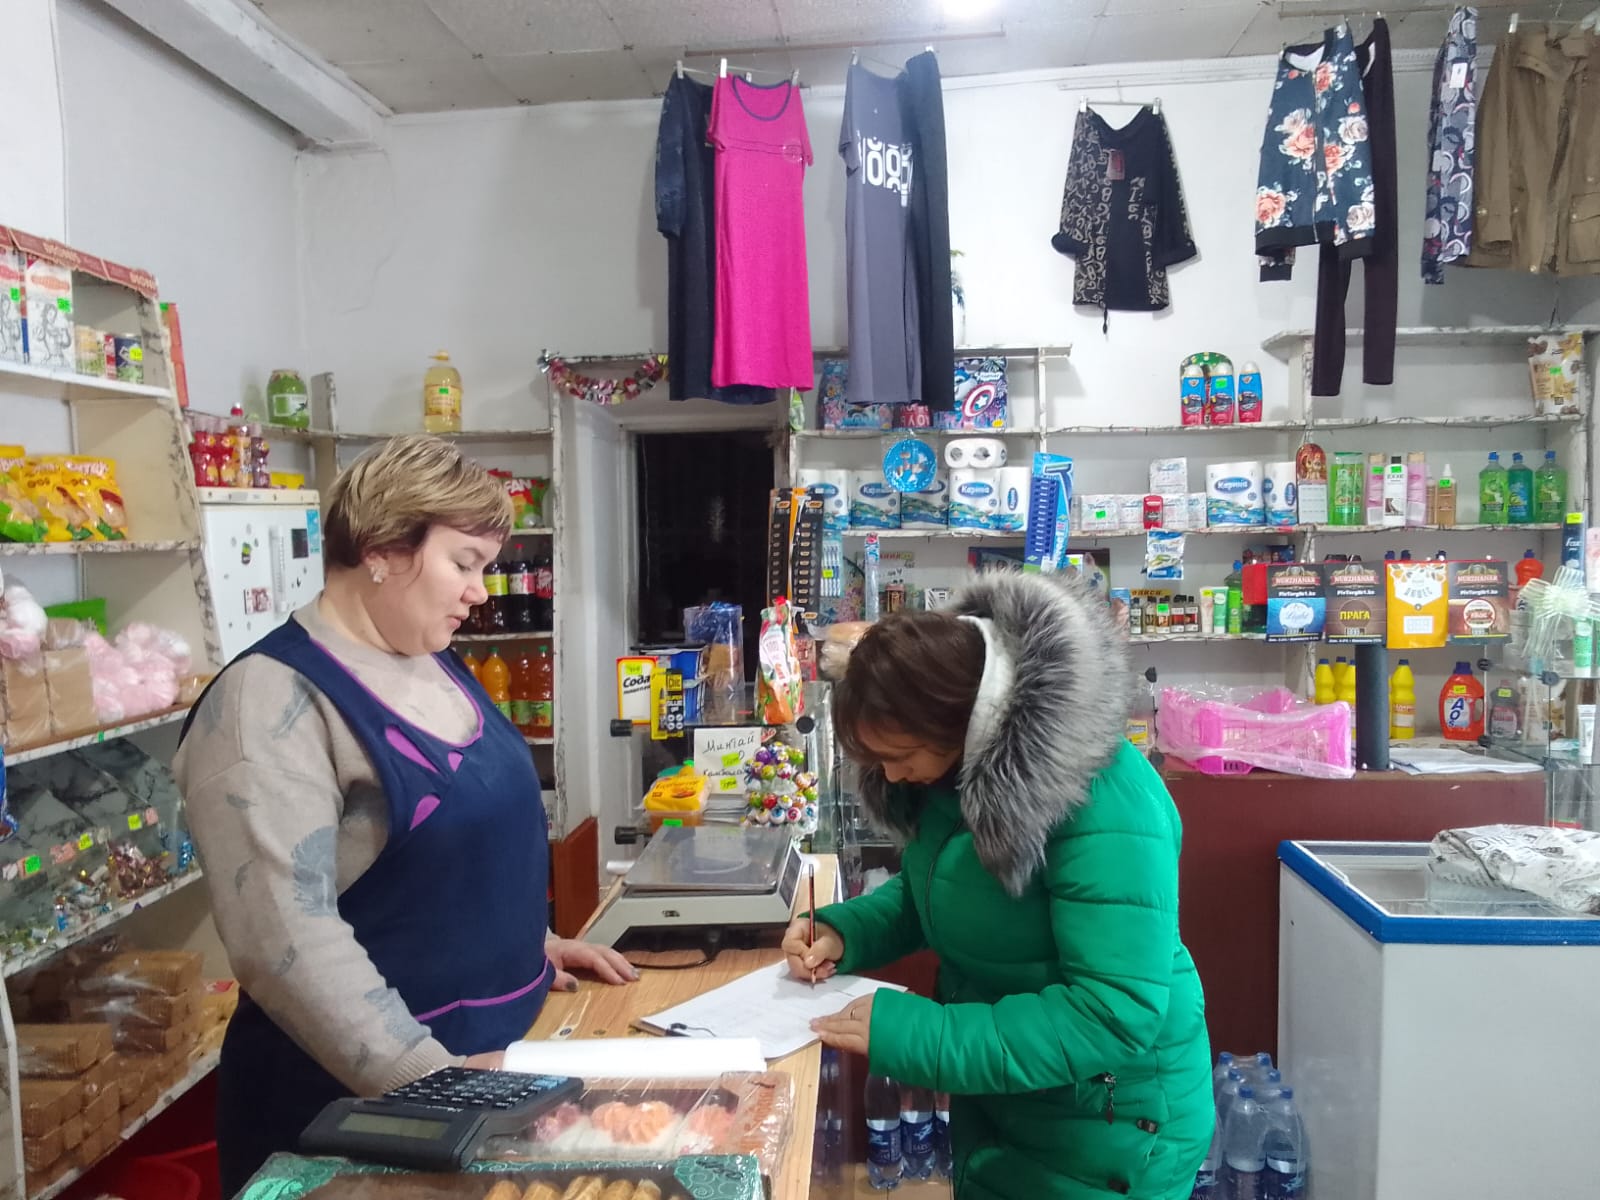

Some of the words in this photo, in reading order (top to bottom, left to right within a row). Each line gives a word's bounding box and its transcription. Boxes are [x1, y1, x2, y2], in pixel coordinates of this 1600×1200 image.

[961, 485, 990, 496] Карина
[1217, 478, 1249, 491] Карина
[1340, 611, 1370, 620] ПРАГА
[623, 675, 651, 688] Сода
[703, 731, 754, 754] Минтай
